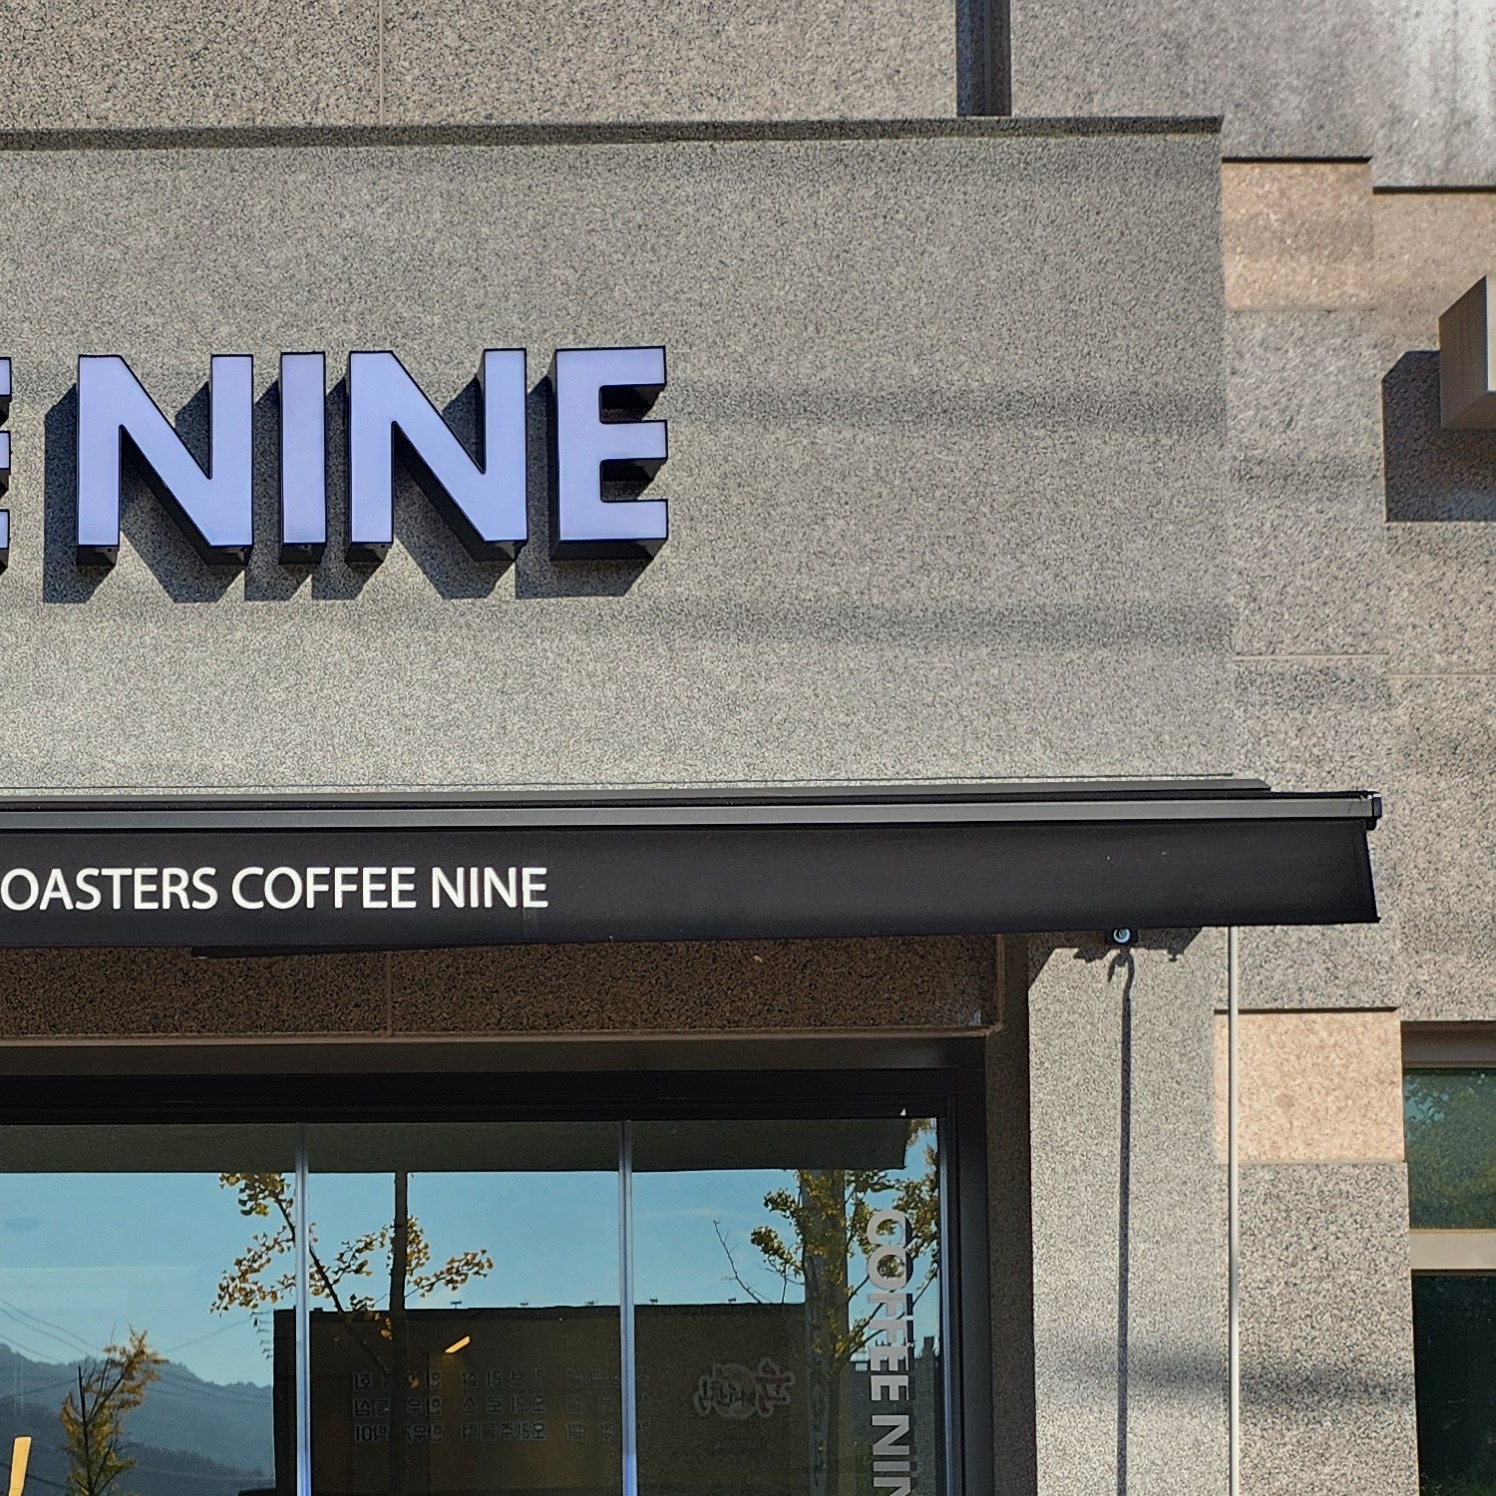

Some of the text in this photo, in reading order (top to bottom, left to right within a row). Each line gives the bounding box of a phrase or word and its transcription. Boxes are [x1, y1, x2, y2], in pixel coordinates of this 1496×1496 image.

[76, 346, 669, 566] NINE
[232, 867, 416, 909] COFFEE
[432, 867, 548, 908] NINE
[866, 1209, 910, 1401] COFFEE
